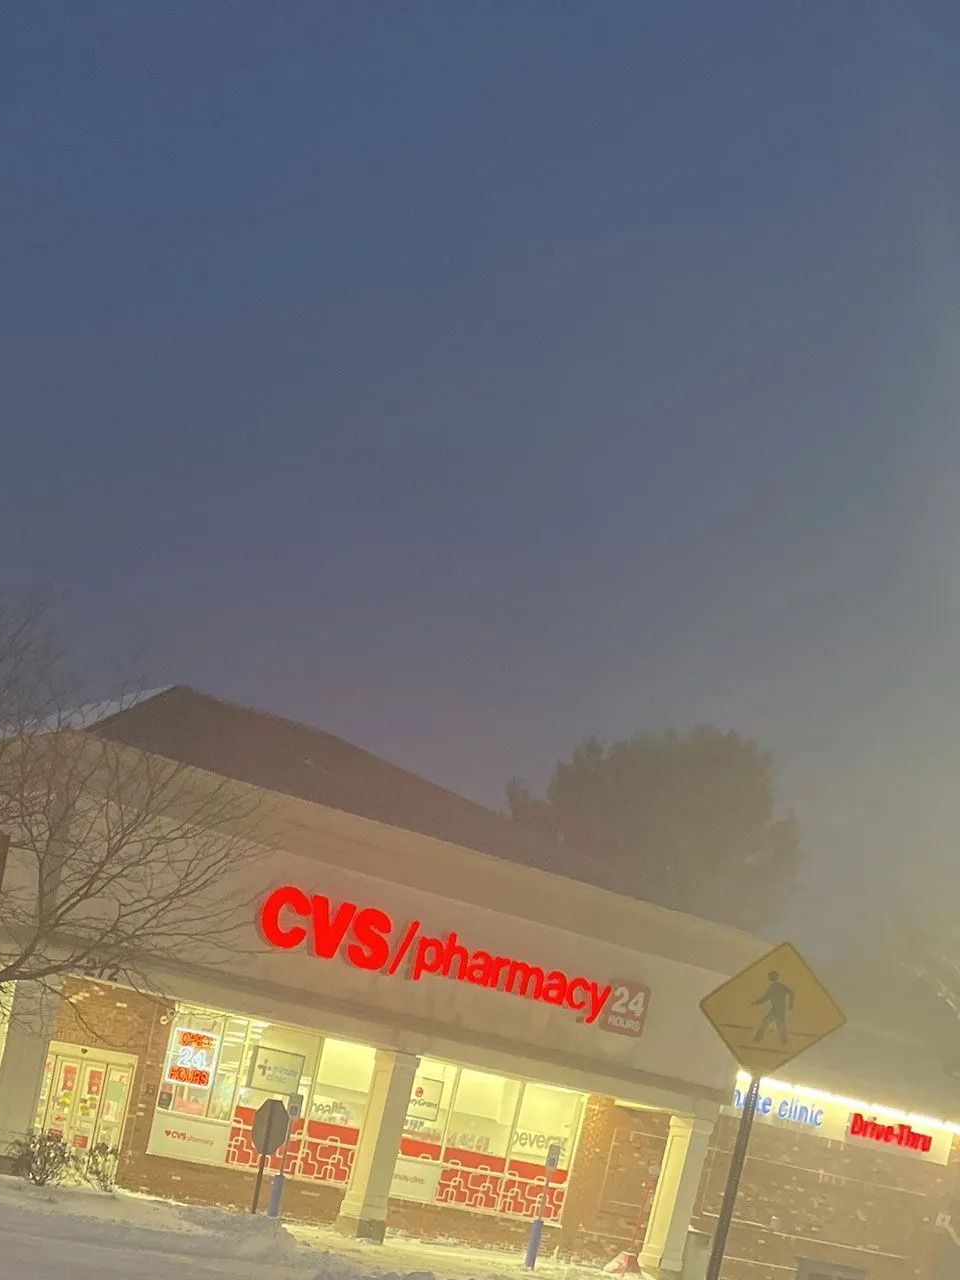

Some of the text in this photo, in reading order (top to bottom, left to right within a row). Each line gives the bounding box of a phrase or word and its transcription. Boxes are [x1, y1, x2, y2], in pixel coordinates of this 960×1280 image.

[259, 885, 612, 1024] CVS/pharmacy
[611, 986, 645, 1017] 24
[607, 1015, 641, 1032] HOURS
[176, 1047, 207, 1070] 24
[168, 1065, 209, 1086] HOURS
[778, 1099, 824, 1126] clinic
[850, 1113, 932, 1152] Drive-Thru
